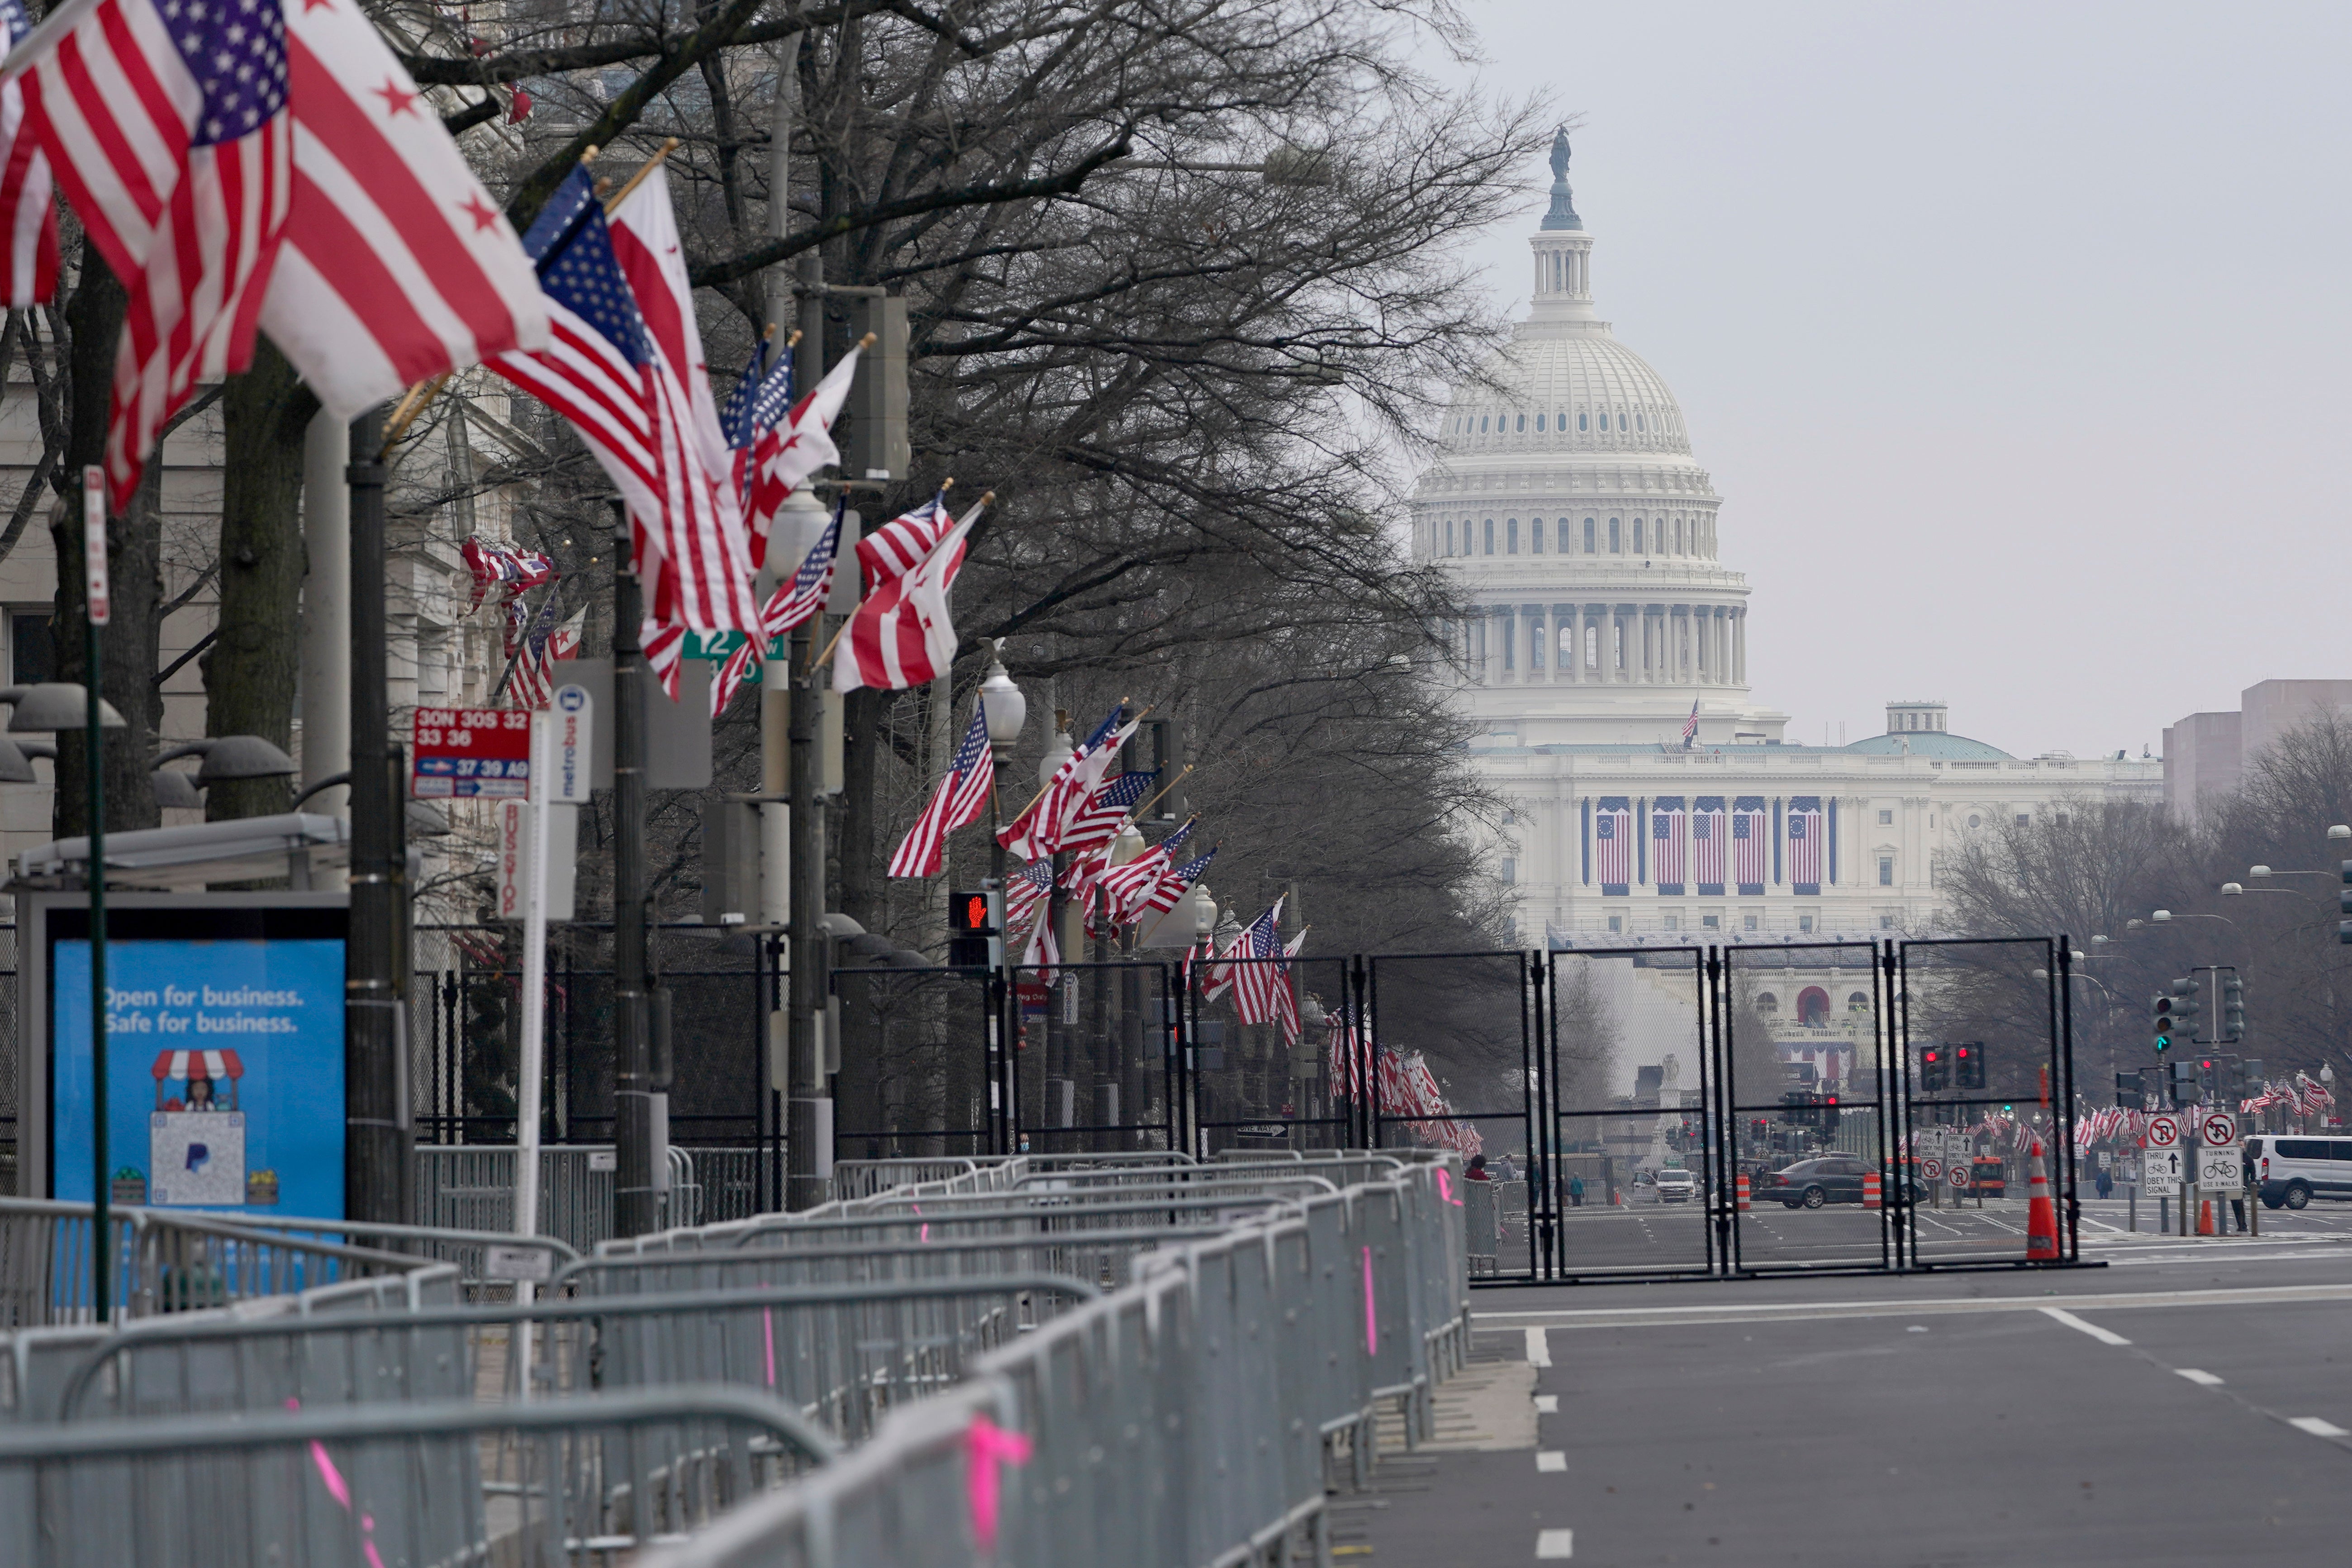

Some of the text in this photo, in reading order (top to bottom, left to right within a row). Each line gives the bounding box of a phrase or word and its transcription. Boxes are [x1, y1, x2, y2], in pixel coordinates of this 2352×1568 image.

[418, 710, 527, 730] 30N 30S 32
[417, 728, 472, 747] 33 36
[561, 715, 577, 797] metrobus
[456, 759, 477, 776] 37
[480, 760, 503, 777] 39
[506, 761, 528, 778] A9
[502, 804, 518, 917] BUS STOP
[164, 984, 197, 1006] for
[202, 984, 304, 1007] business.
[105, 1010, 298, 1033] Safe for business.
[2146, 1152, 2164, 1160] THRU
[2148, 1186, 2171, 1194] SIGNAL
